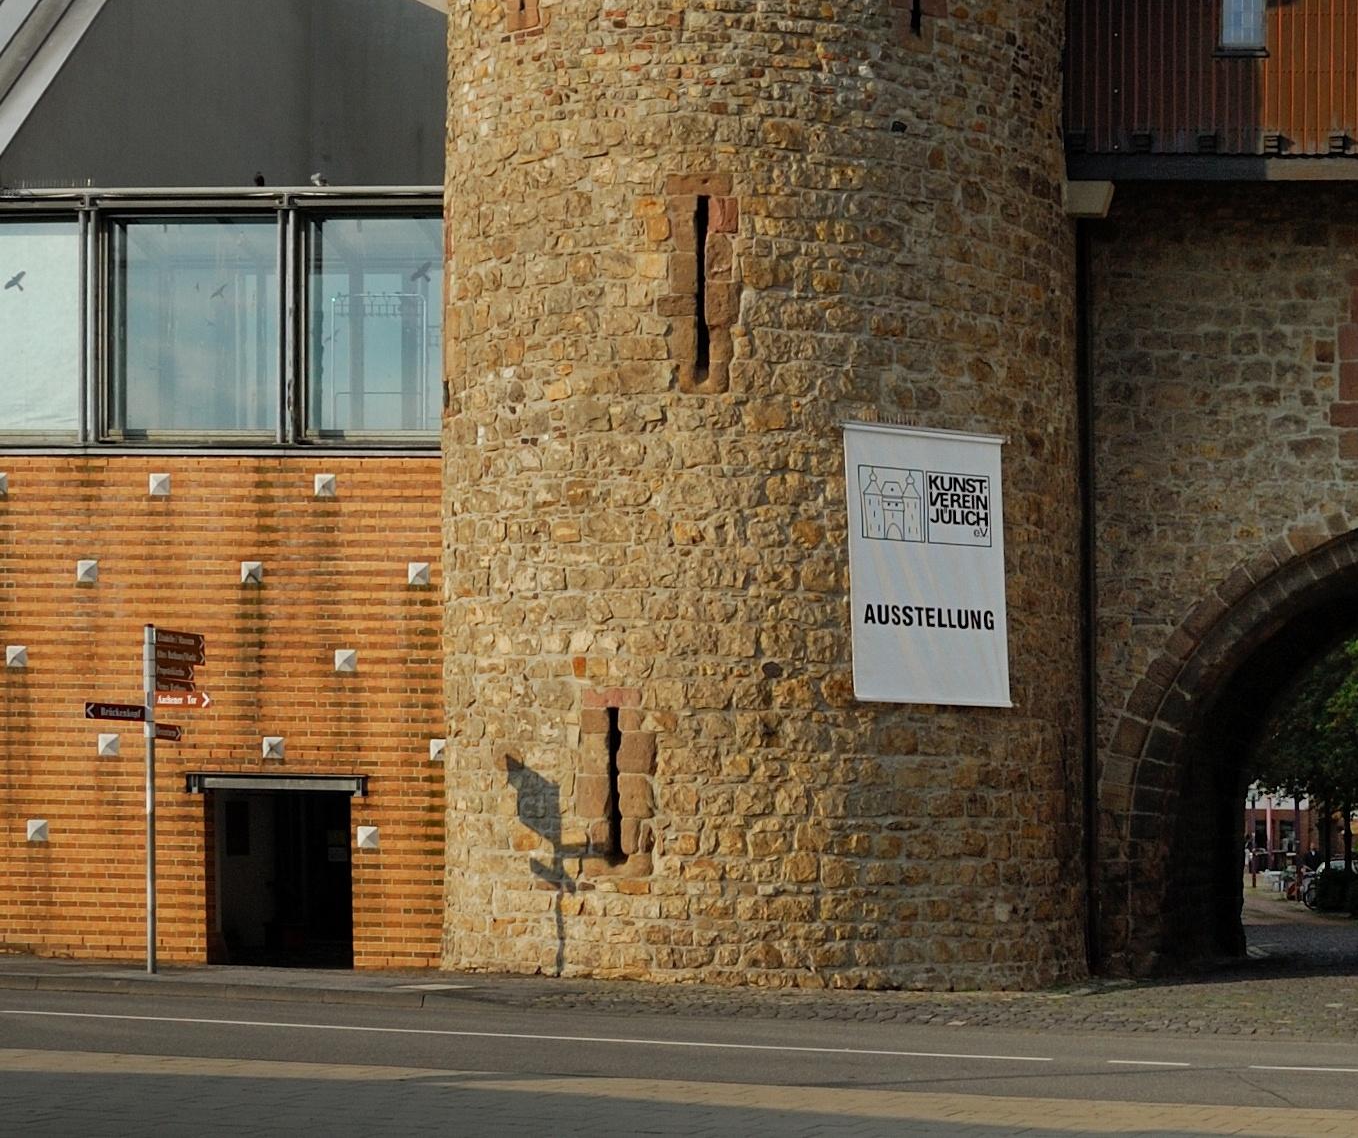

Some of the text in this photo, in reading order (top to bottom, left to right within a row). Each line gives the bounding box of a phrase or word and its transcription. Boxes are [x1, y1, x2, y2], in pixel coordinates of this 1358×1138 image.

[928, 474, 987, 494] KUNST-
[929, 491, 988, 511] VEREIN
[930, 507, 988, 527] JÜLICH
[864, 603, 995, 630] AUSSTELLUNG
